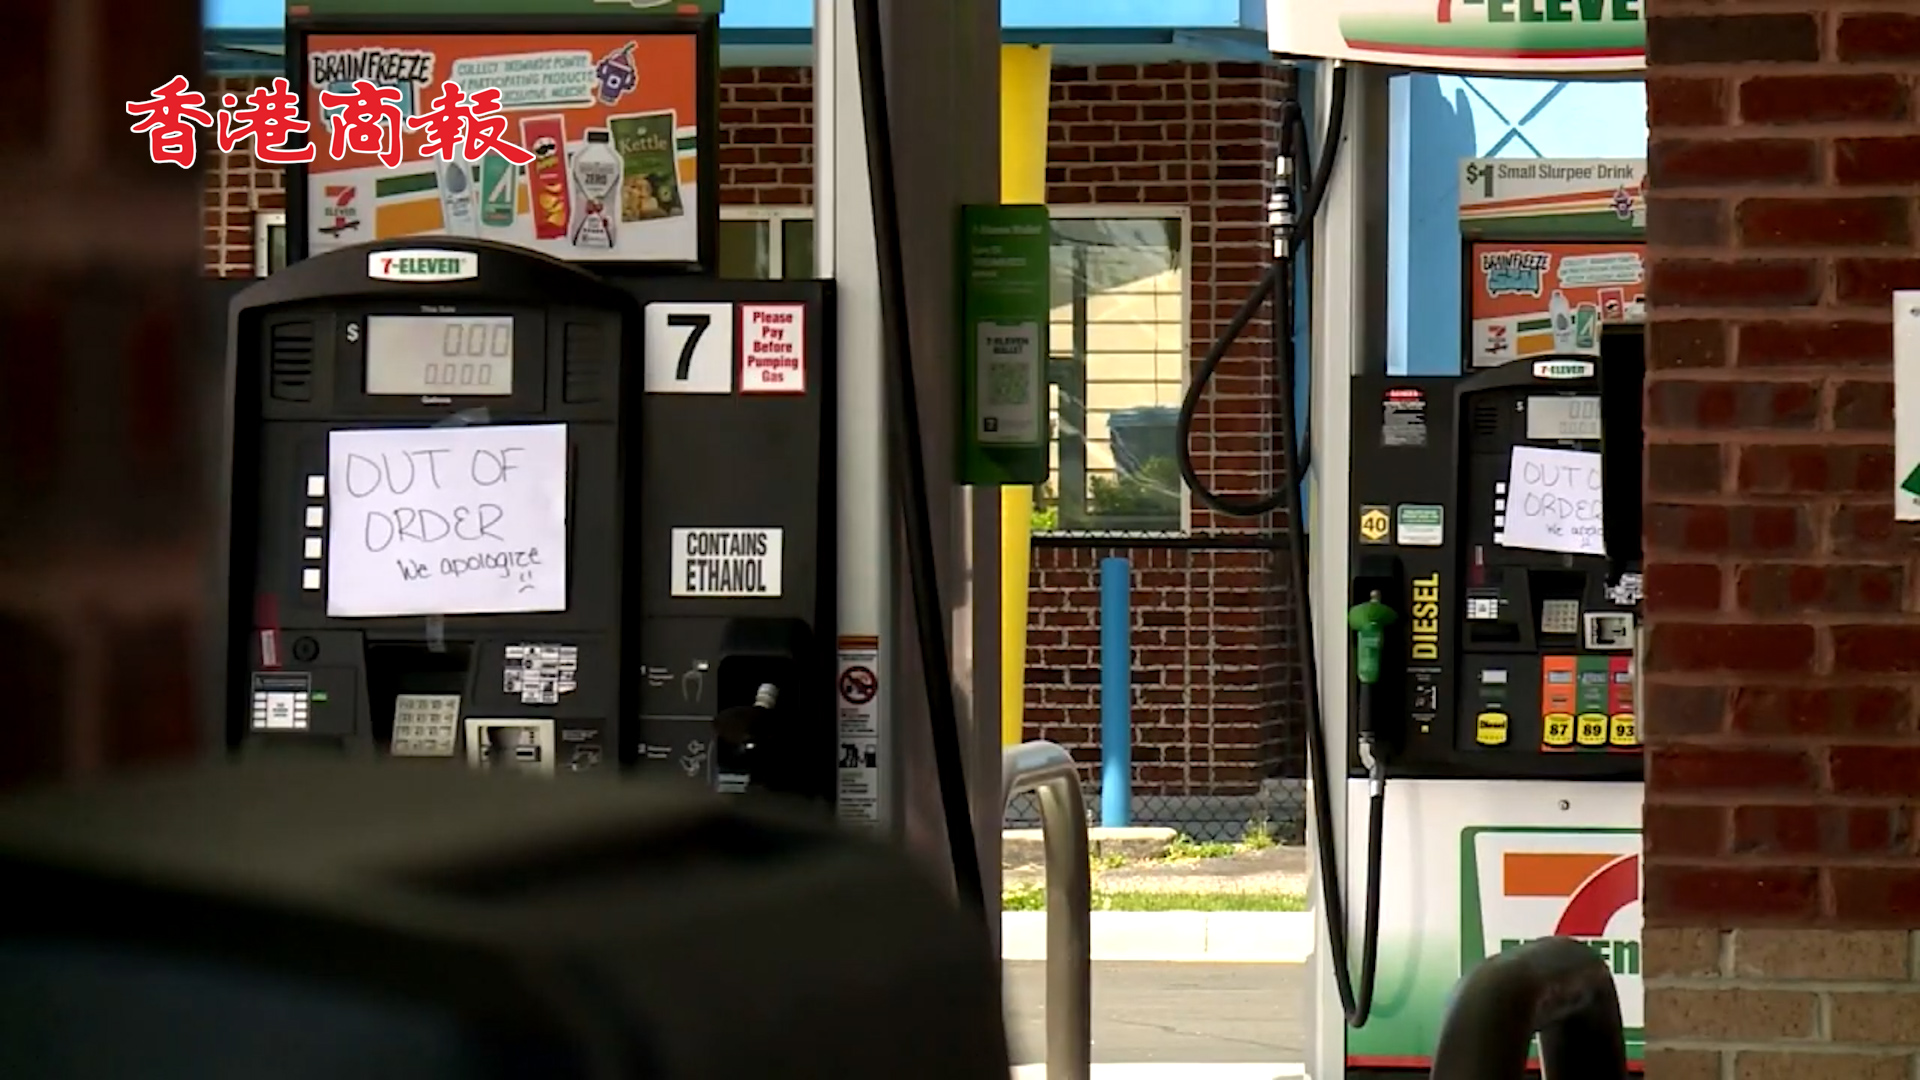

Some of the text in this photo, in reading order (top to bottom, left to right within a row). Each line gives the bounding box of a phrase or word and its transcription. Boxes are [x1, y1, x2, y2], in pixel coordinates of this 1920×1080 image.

[619, 134, 667, 152] Kettle
[1466, 163, 1494, 198] $1
[1498, 164, 1536, 179] Small
[1597, 164, 1634, 179] Drink
[753, 311, 793, 323] Please
[347, 323, 359, 342] $
[762, 326, 784, 340] Pay
[667, 314, 711, 380] 7
[753, 341, 793, 353] Before
[748, 355, 799, 369] Pumping
[762, 370, 784, 382] Gas
[346, 448, 525, 498] OUT OF
[1524, 461, 1581, 487] OUT
[366, 503, 504, 552] ORDER
[1363, 517, 1387, 533] 40
[687, 532, 768, 556] CONTAINS
[397, 547, 542, 581] We apologize
[686, 558, 767, 592] ETHANOL
[1412, 572, 1440, 660] DIESEL
[1549, 724, 1635, 736] 87 89 93
